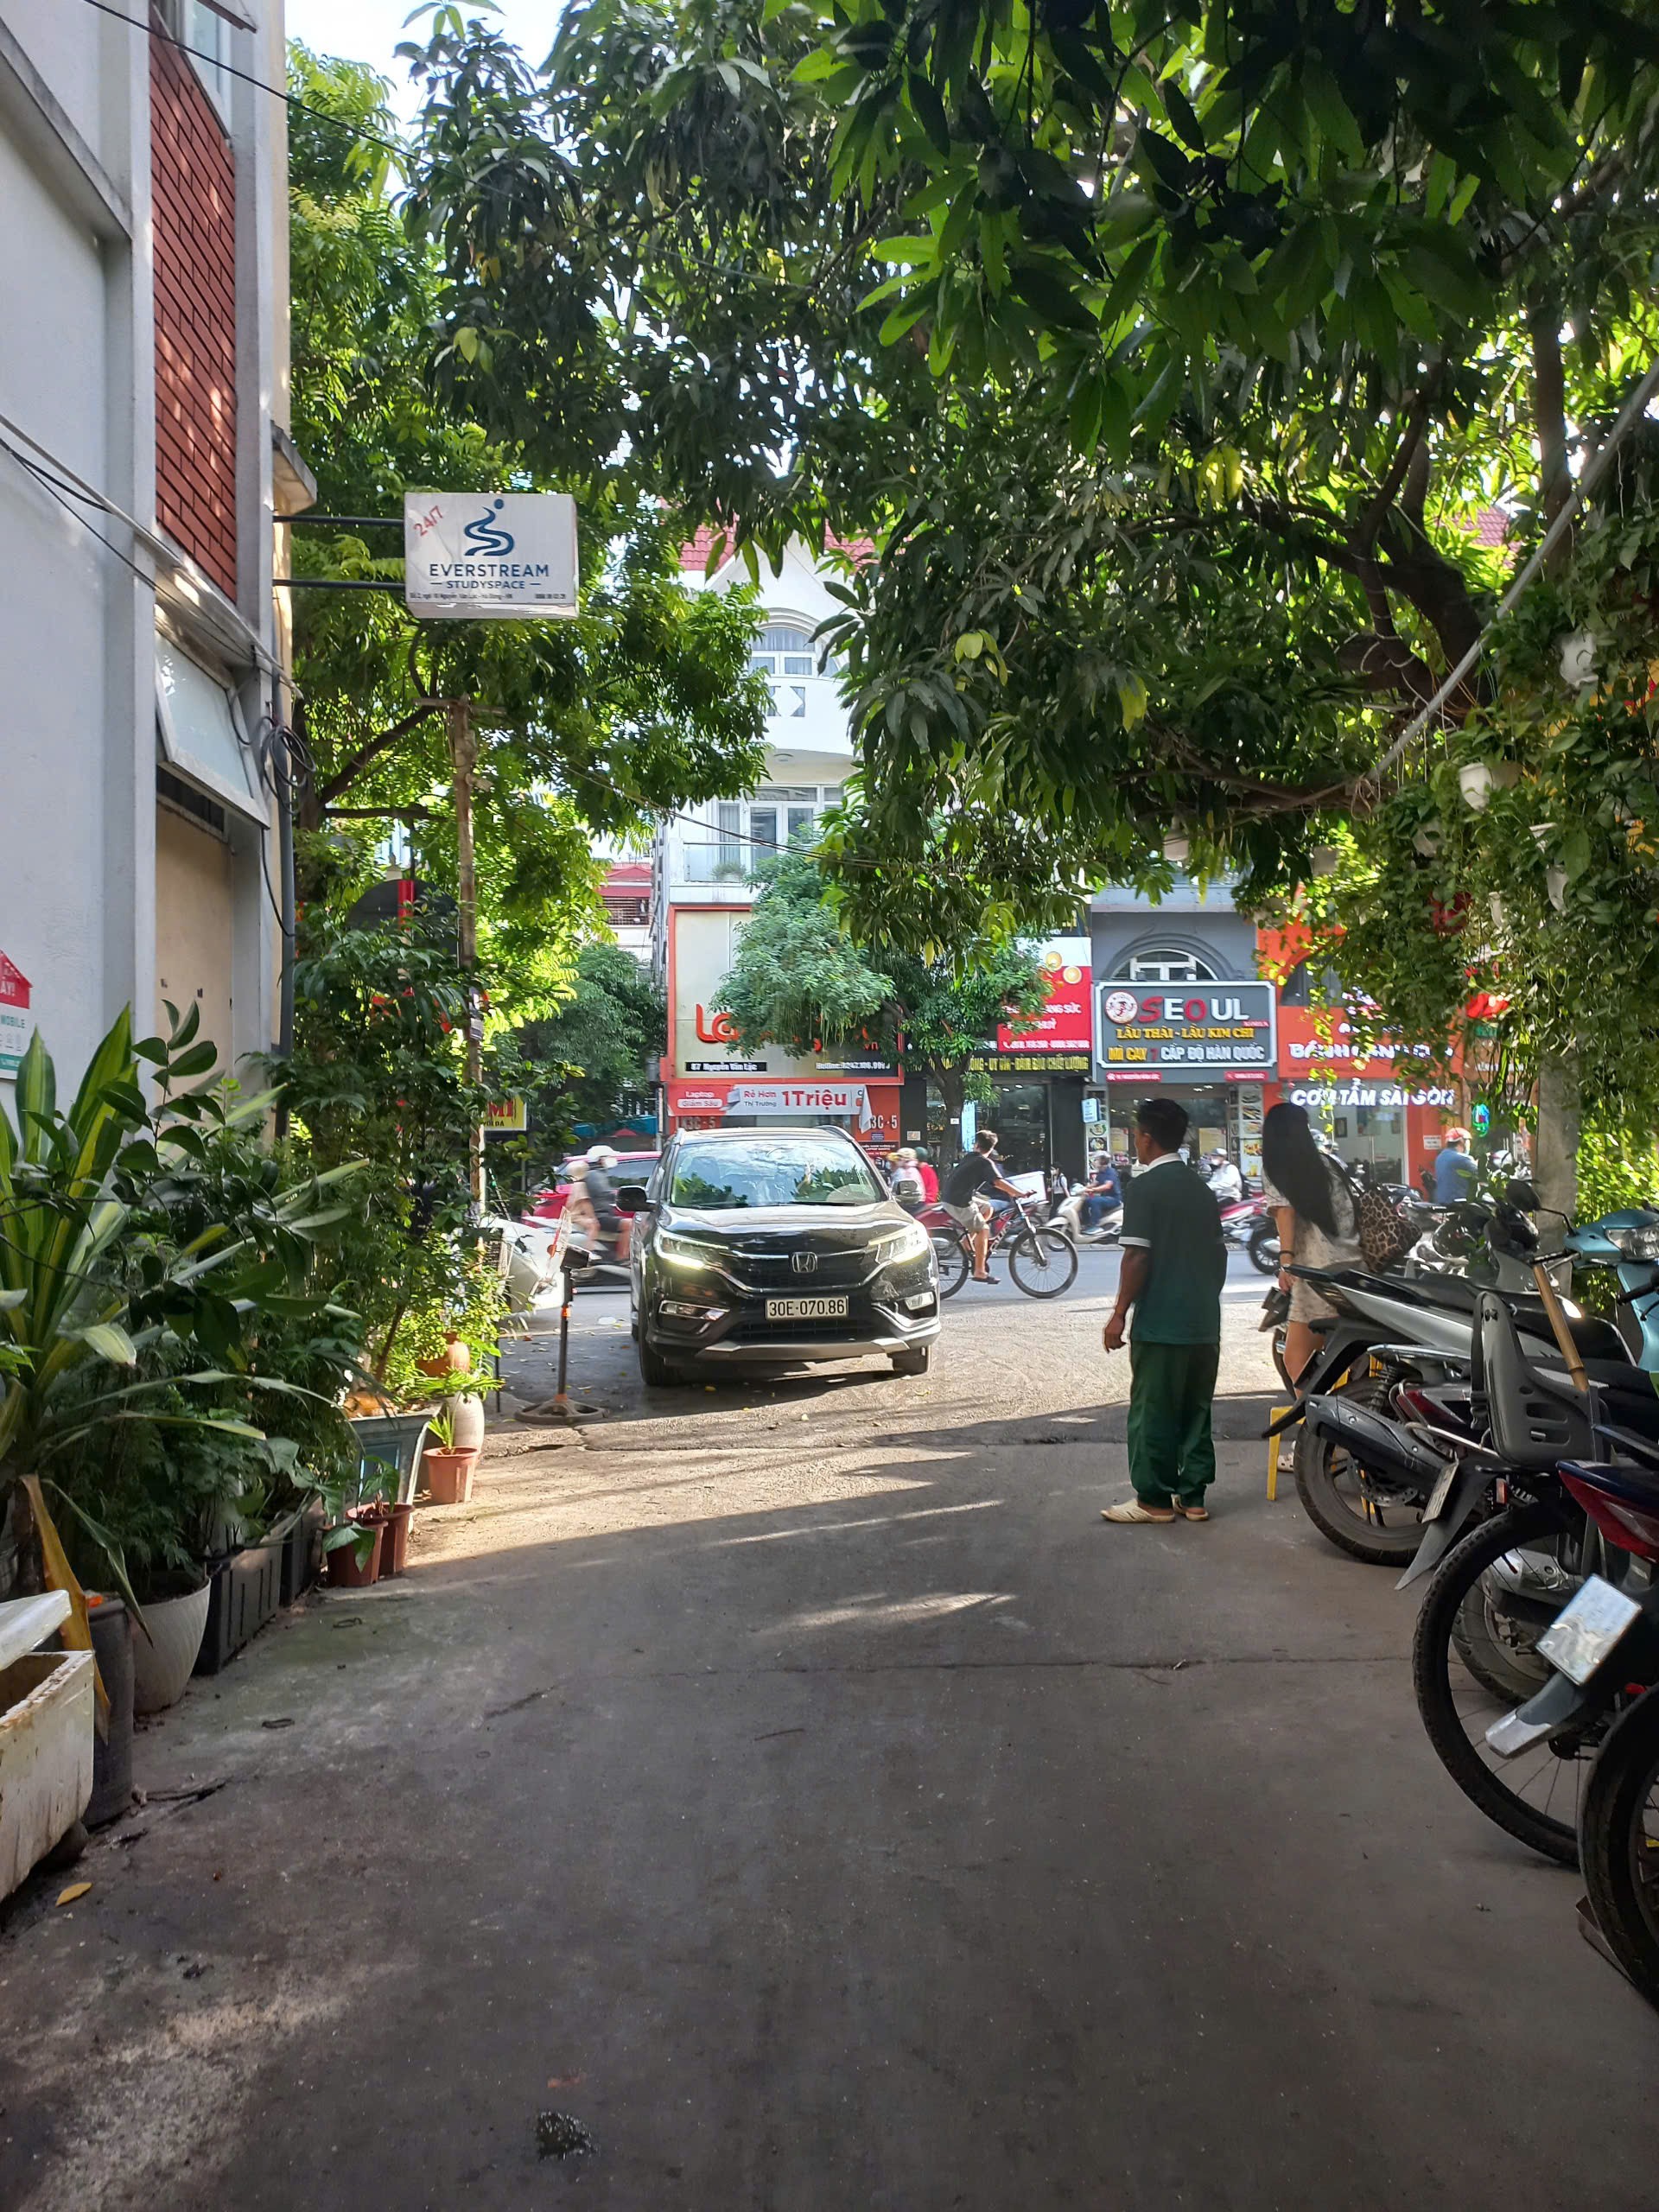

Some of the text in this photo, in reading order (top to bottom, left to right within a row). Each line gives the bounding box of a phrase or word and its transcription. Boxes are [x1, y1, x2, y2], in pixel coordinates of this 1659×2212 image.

[413, 505, 444, 537] 24/7
[429, 563, 549, 577] EVERSTREAM
[447, 581, 525, 589] STUDYSPACE
[1138, 996, 1249, 1023] SEOUL
[1207, 1027, 1231, 1039] KIM
[1232, 1027, 1255, 1039] CHI
[1126, 1046, 1148, 1061] CAY
[1150, 1047, 1159, 1061] 7
[685, 1090, 715, 1099] Laptop
[769, 1300, 845, 1317] 30E-070.86
